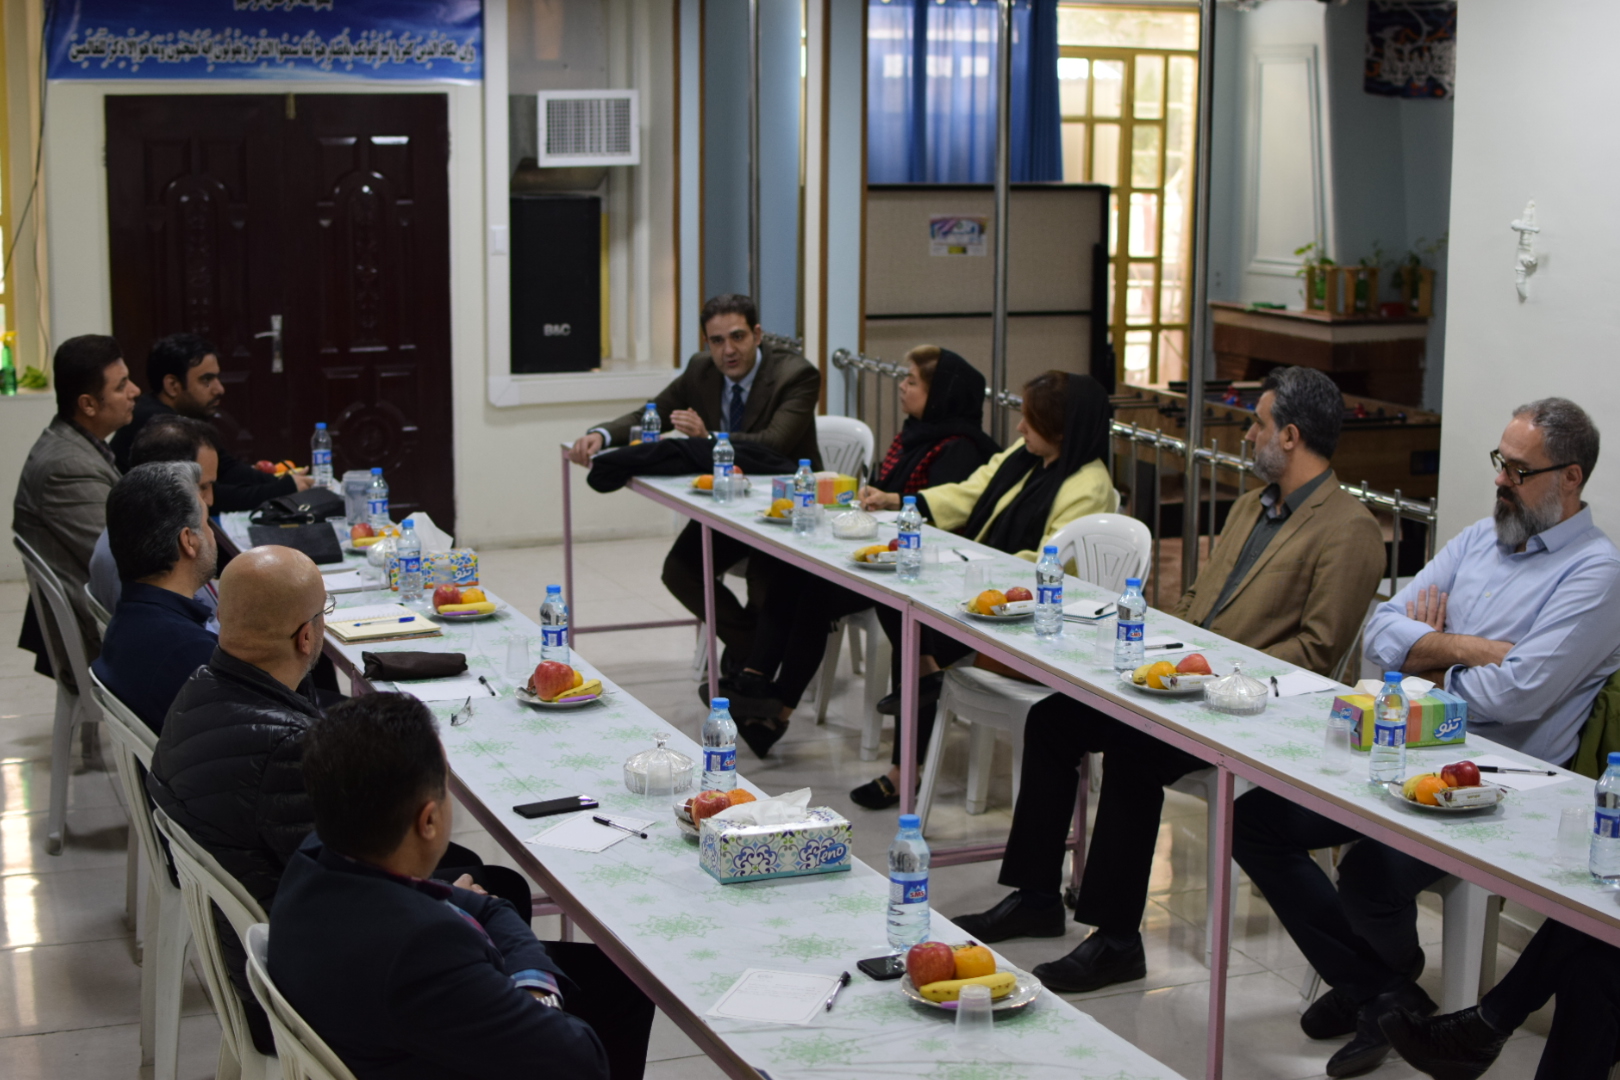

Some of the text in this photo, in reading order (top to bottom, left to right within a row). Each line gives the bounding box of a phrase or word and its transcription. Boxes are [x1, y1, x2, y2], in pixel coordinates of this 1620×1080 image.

[453, 567, 474, 581] تنو
[1435, 717, 1462, 737] تنو
[813, 846, 844, 865] Teno
